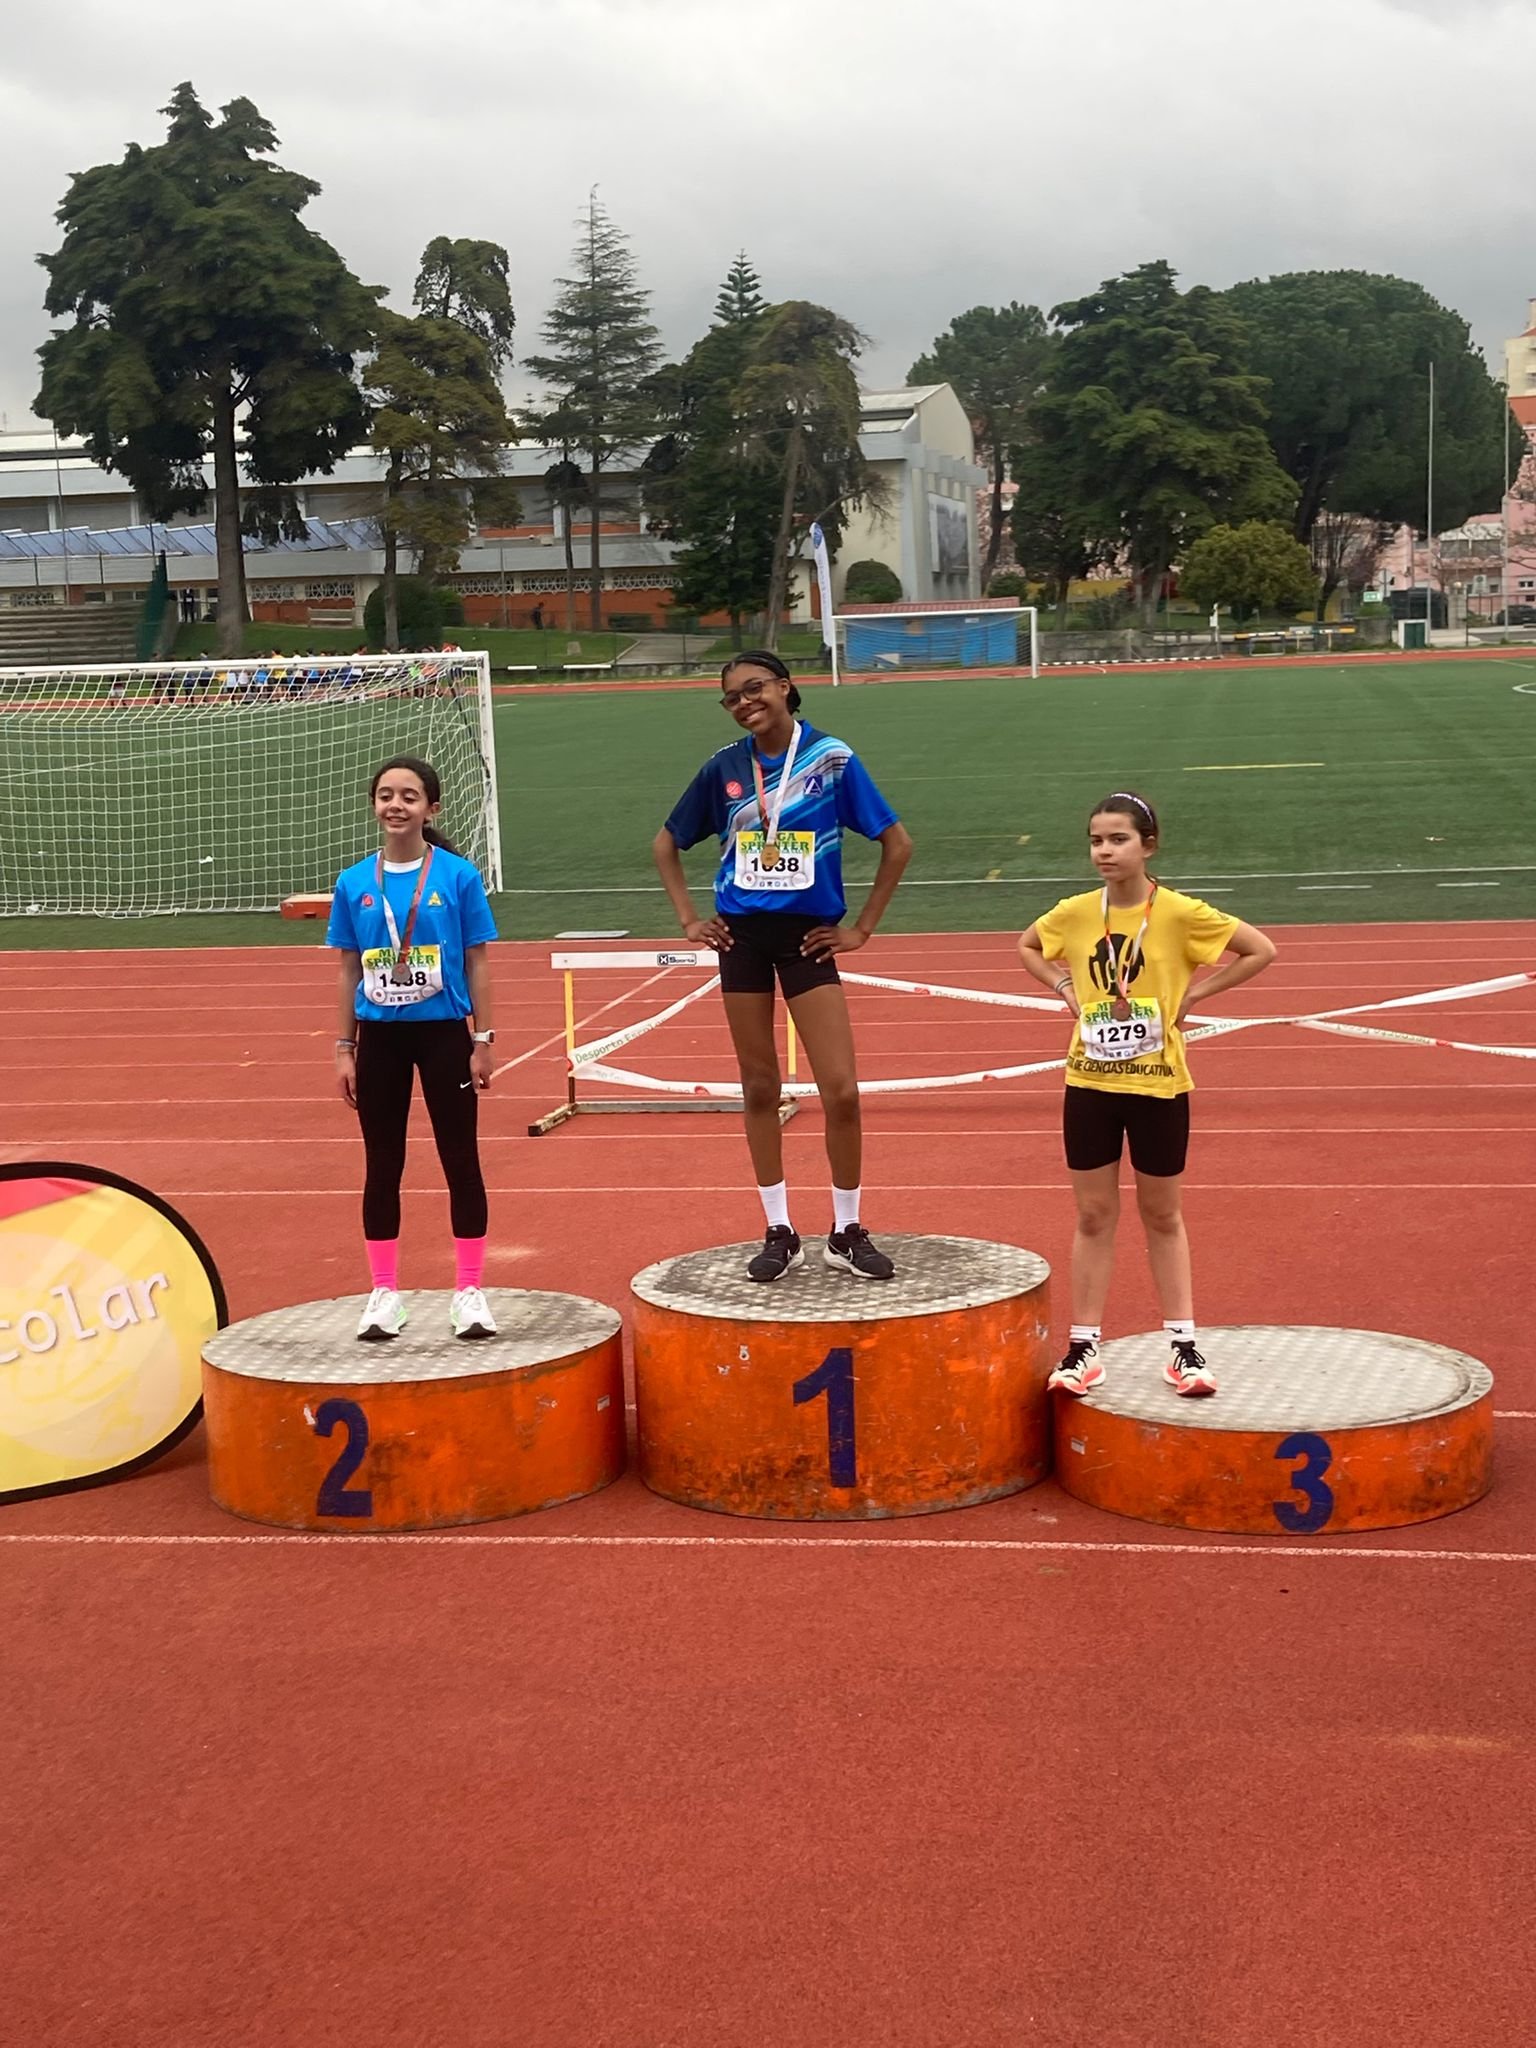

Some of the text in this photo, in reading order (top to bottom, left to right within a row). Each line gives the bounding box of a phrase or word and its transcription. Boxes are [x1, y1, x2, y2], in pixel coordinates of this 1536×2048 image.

[1097, 1023, 1147, 1044] 1279
[313, 1397, 373, 1517] 2
[793, 1347, 857, 1488] 1
[1272, 1431, 1335, 1533] 3
